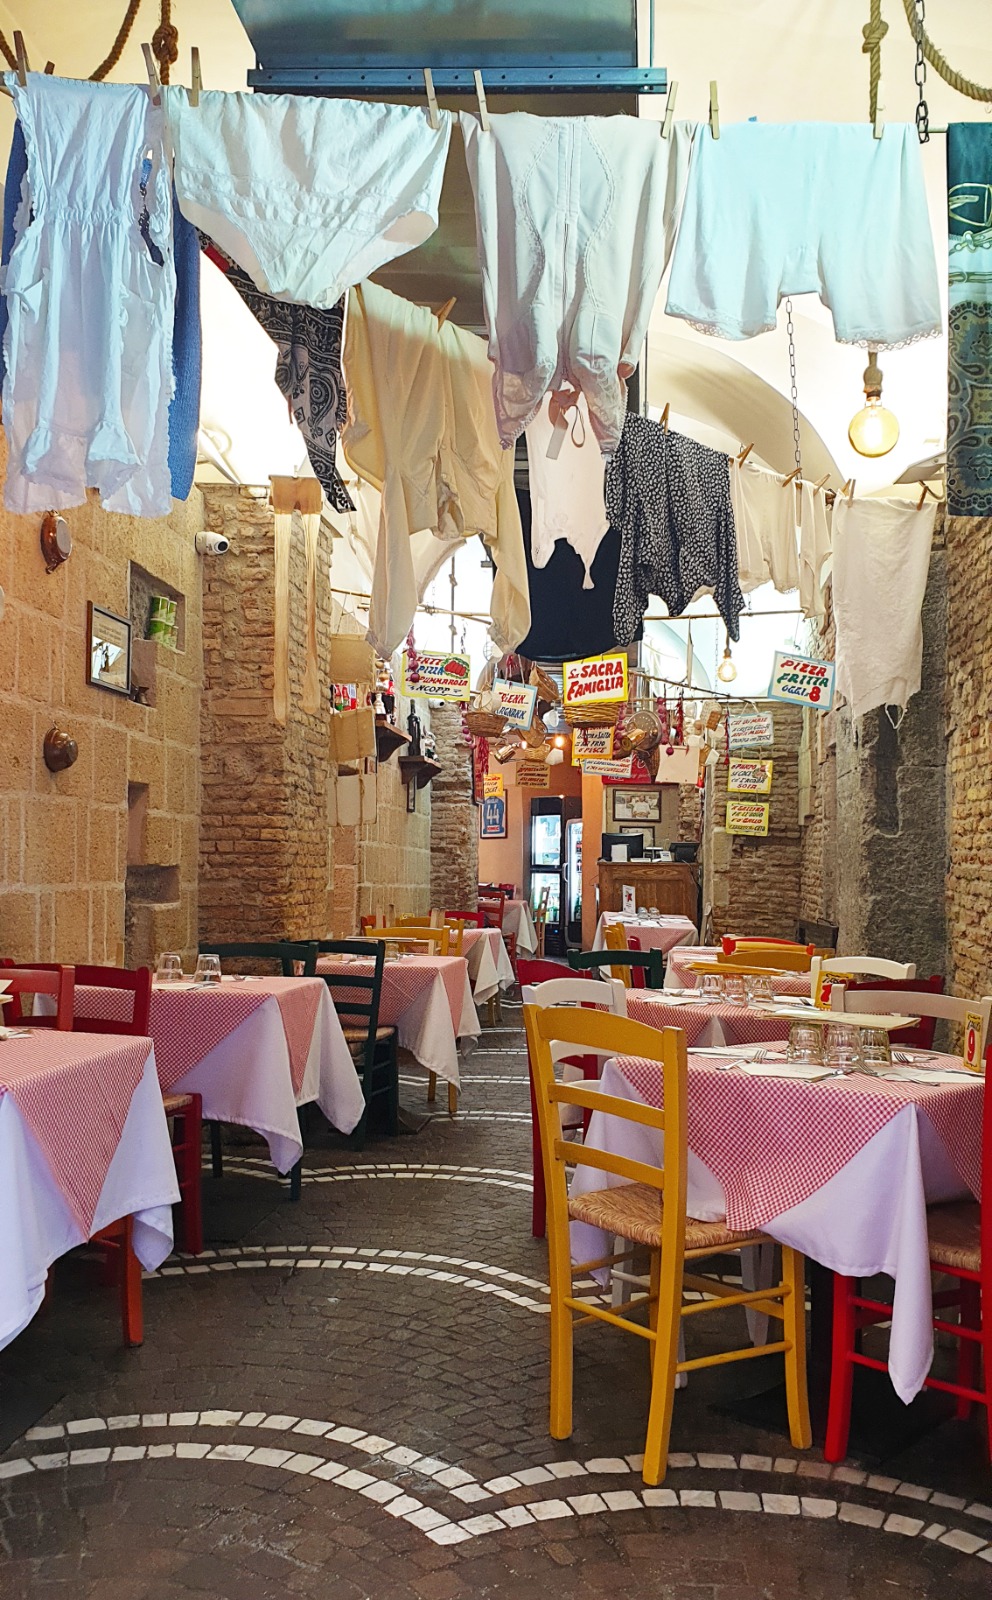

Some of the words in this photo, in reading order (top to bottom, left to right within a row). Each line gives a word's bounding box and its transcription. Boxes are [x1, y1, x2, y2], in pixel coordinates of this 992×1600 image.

[416, 665, 444, 676] PIZZA
[581, 661, 623, 679] SACRA
[780, 659, 828, 677] PIZZA
[567, 676, 623, 701] FAMIGLIA
[776, 672, 830, 688] FRITTA
[781, 684, 806, 696] OGGI
[486, 803, 499, 825] 44
